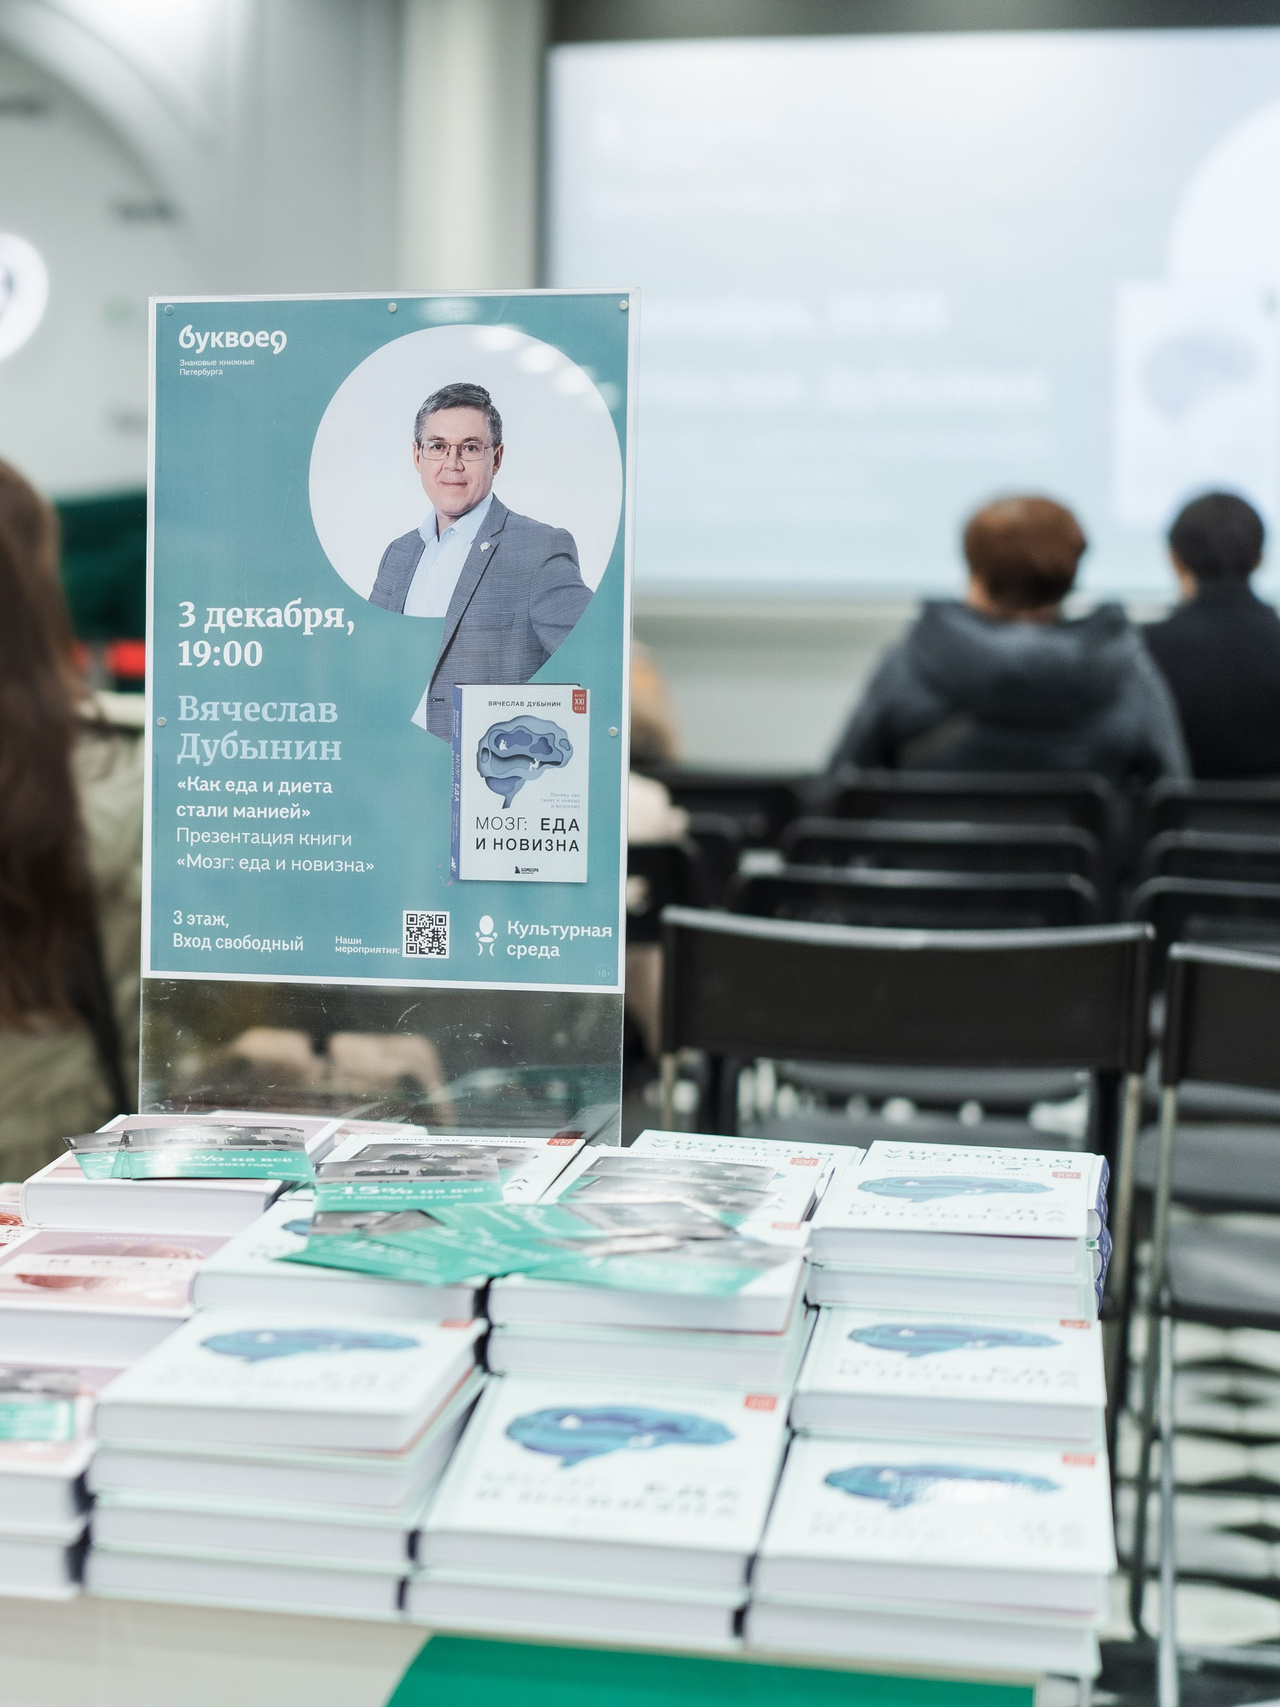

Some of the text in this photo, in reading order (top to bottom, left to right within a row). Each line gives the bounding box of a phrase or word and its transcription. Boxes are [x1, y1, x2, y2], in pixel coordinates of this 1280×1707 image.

[178, 324, 287, 355] буквоед
[179, 358, 255, 367] Знаковые книжные
[179, 367, 223, 377] Петербурга
[178, 597, 355, 636] 3 декабря,
[178, 640, 263, 667] 19:00
[177, 695, 339, 723] Вячеслав
[176, 730, 342, 767] Дубынин
[177, 776, 333, 796] «Как еда и диета
[176, 803, 311, 819] стали манией»
[475, 816, 528, 831] МОЗГ:
[540, 817, 580, 834] ЕДА
[176, 828, 353, 847] Презентация книги
[475, 838, 580, 852] И НОВИЗНА
[177, 853, 375, 873] «Мозг: еда и новизна»
[173, 910, 230, 929] 3 этаж,
[335, 936, 362, 945] Наши
[507, 920, 612, 942] Культурная
[173, 933, 304, 953] Вход свободный
[335, 946, 400, 956] мероприятия:
[506, 942, 560, 959] среда
